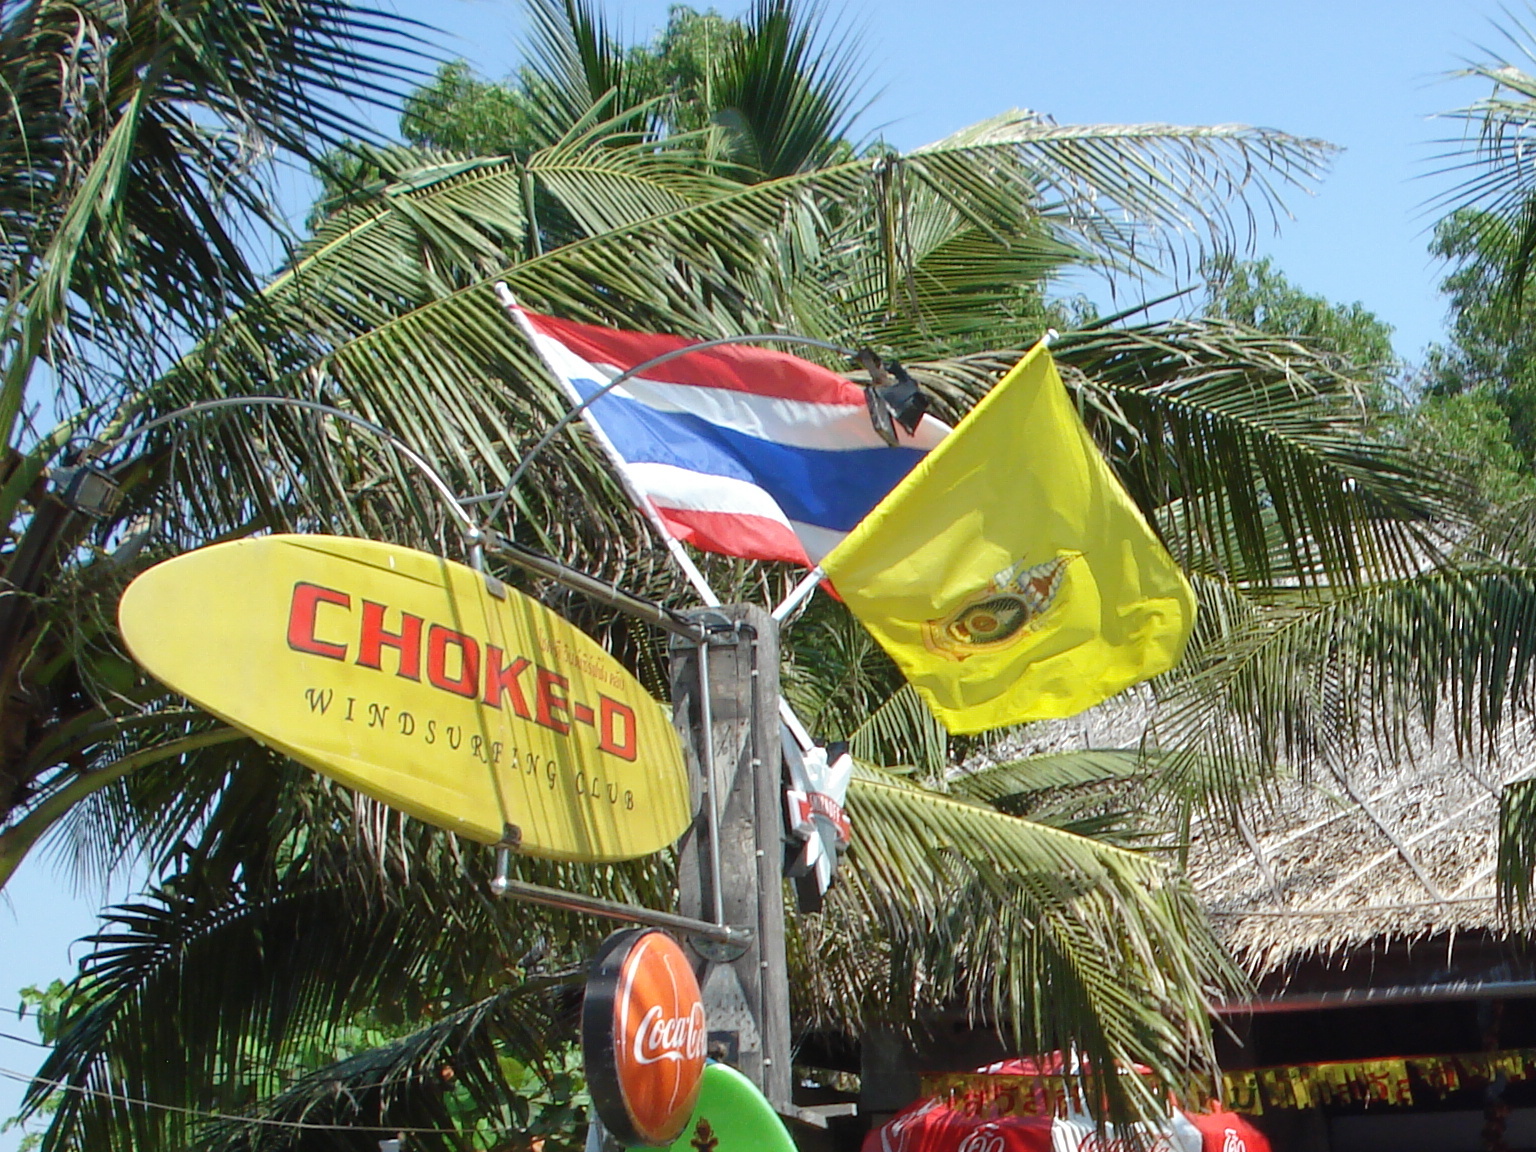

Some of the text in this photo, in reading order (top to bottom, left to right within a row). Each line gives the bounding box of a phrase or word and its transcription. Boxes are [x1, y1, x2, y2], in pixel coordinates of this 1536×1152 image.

[287, 581, 637, 763] CHOKE-D
[305, 688, 635, 811] WINDSURFING CLUB
